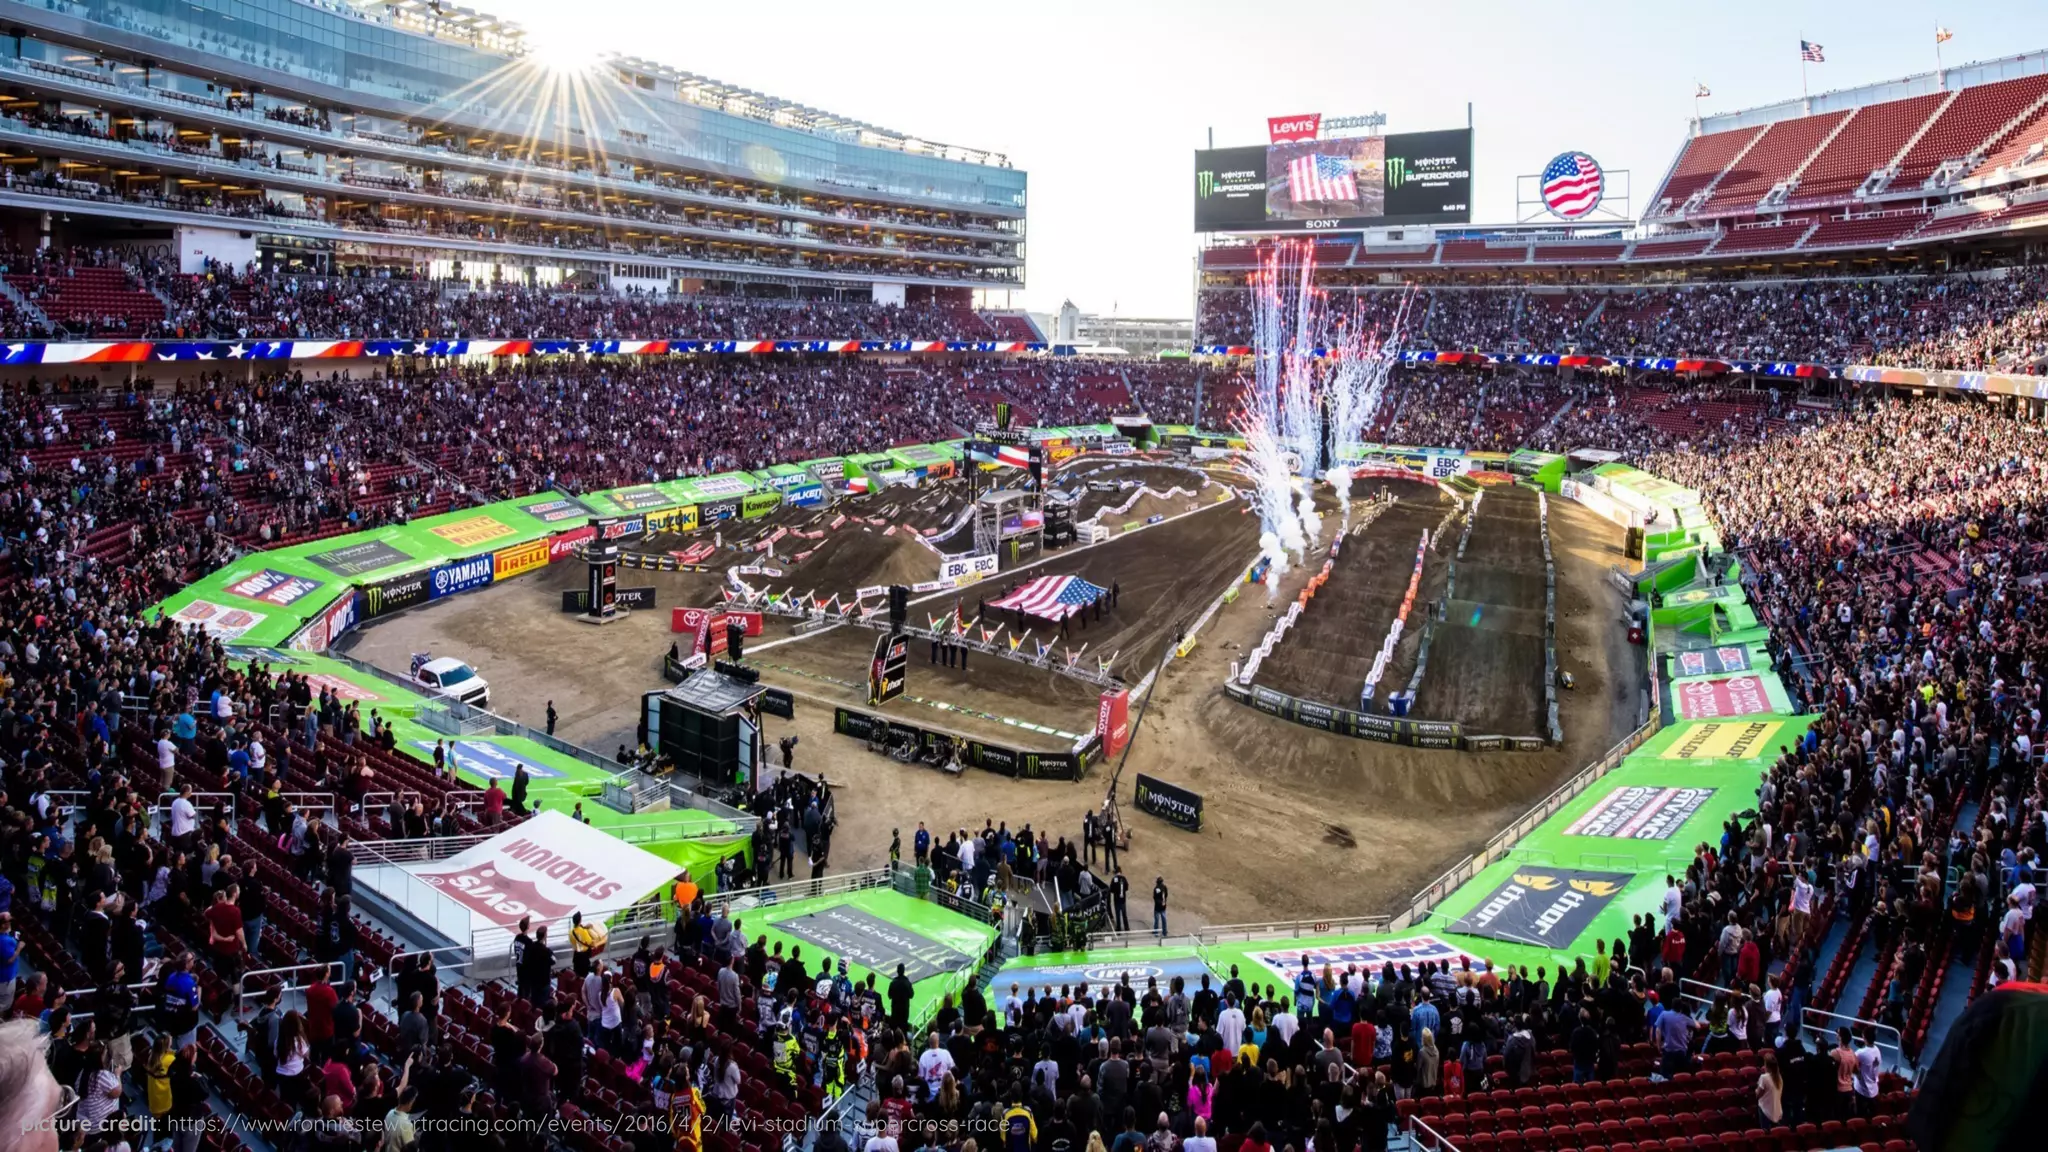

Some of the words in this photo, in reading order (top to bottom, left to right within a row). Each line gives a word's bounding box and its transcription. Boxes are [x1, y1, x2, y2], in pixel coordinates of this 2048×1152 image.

[1324, 111, 1386, 130] STADIUM
[1414, 157, 1457, 166] MONSTER
[1221, 170, 1256, 180] MONSTER
[1405, 170, 1469, 182] SUPERCROSS
[1214, 183, 1265, 192] SUPERCROSS
[1306, 220, 1340, 229] SONY
[986, 430, 1020, 440] MONSTER
[1436, 458, 1460, 469] EBC
[1433, 468, 1456, 477] EBC
[704, 504, 736, 516] GoPro
[602, 519, 644, 539] AMSOIL
[560, 535, 595, 552] HONDA
[494, 540, 548, 574] PIRELLI
[448, 559, 490, 585] YAMAHA
[948, 564, 968, 577] EBC
[974, 558, 994, 572] EBC
[234, 571, 284, 597] 100%
[268, 578, 315, 603] 100%
[382, 582, 422, 599] MONSTER
[440, 576, 488, 594] RACING
[328, 597, 354, 642] 100%
[887, 678, 904, 691] thor
[1098, 700, 1107, 734] TOYOTA
[1302, 704, 1331, 716] MONSTER
[1359, 716, 1392, 727] MONSTER
[1420, 724, 1450, 732] MONSTER
[1359, 729, 1389, 739] MONSTER
[1677, 724, 1721, 758] DUNLOP
[1726, 722, 1768, 758] DUNLOP
[982, 750, 1012, 763] MONSTER
[1040, 759, 1068, 767] MONSTER
[1148, 790, 1196, 818] MONSTER
[1155, 806, 1189, 822] ENERGY
[500, 838, 622, 900] STADIUM
[1475, 884, 1526, 928] thor
[1534, 890, 1584, 936] thor
[828, 912, 917, 950] MONSTER
[1315, 924, 1329, 932] 123
[787, 921, 880, 964] MONSTER
[1258, 938, 1436, 959] UNLIMITED
[1278, 943, 1454, 968] PARTS
[1098, 968, 1147, 978] MMI
